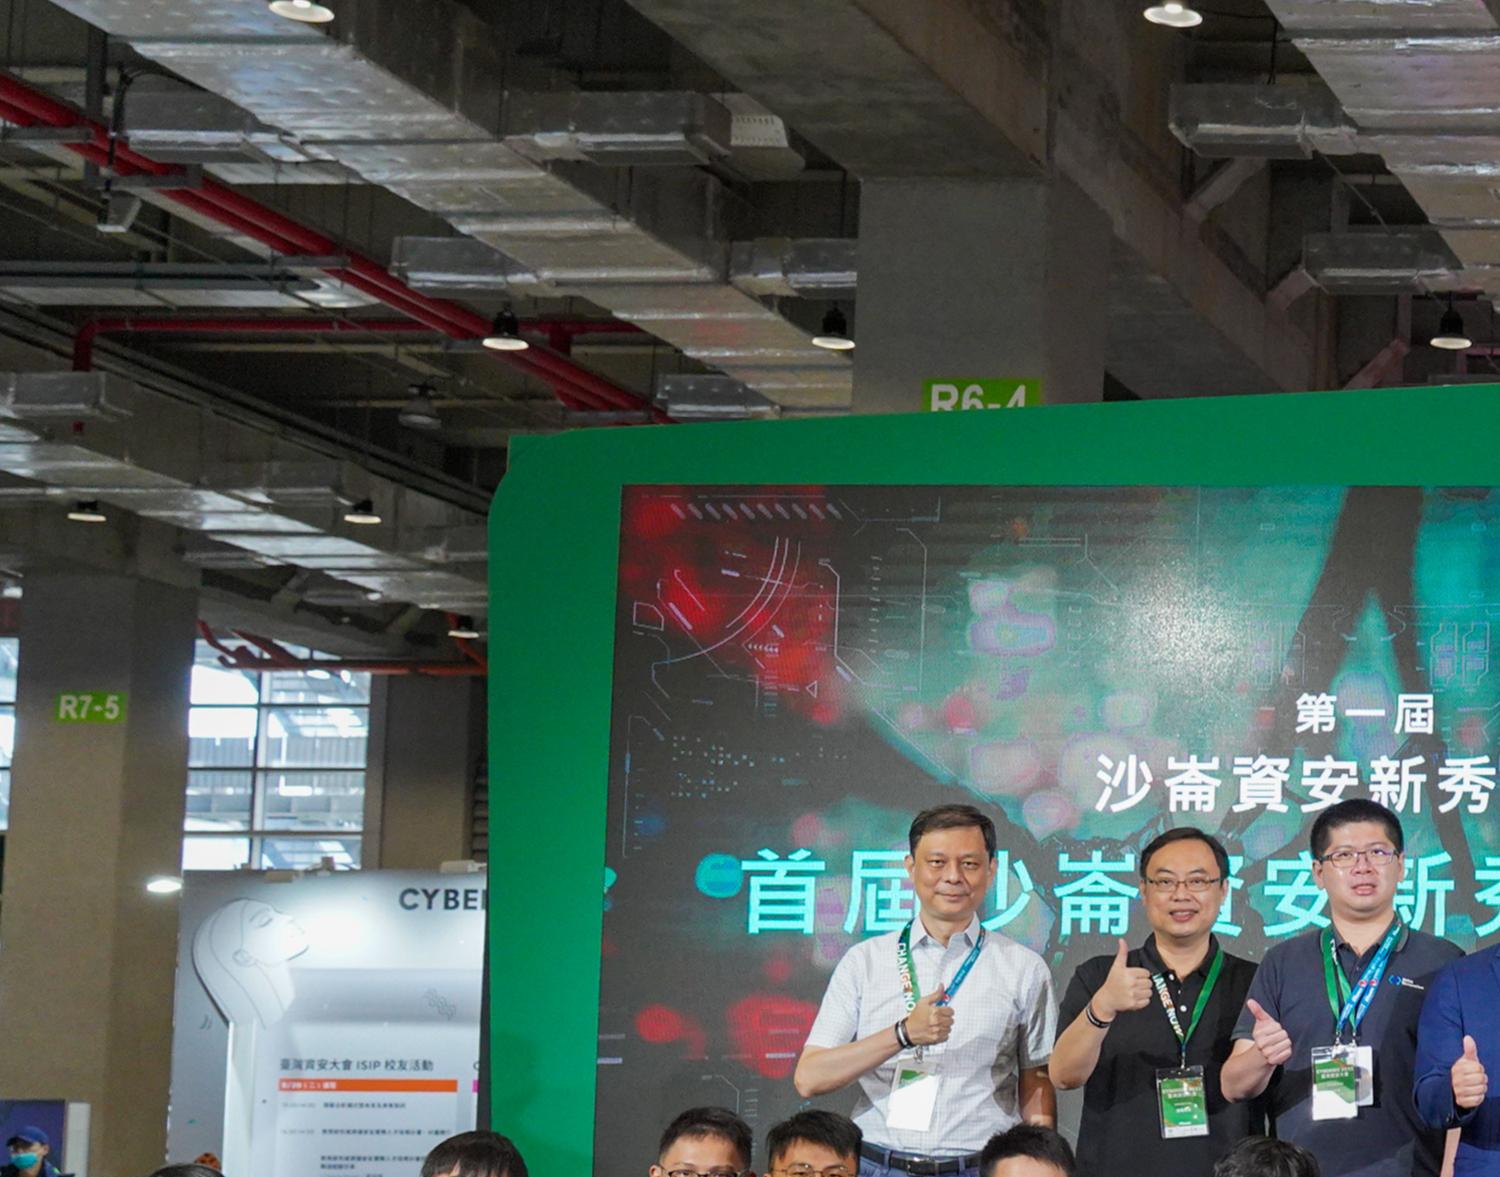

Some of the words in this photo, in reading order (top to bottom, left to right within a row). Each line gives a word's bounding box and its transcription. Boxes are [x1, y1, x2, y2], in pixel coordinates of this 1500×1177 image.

[60, 694, 120, 720] R7-5
[1295, 693, 1435, 736] 第一屆
[898, 942, 914, 992] CHANGE
[903, 992, 918, 1013] NO
